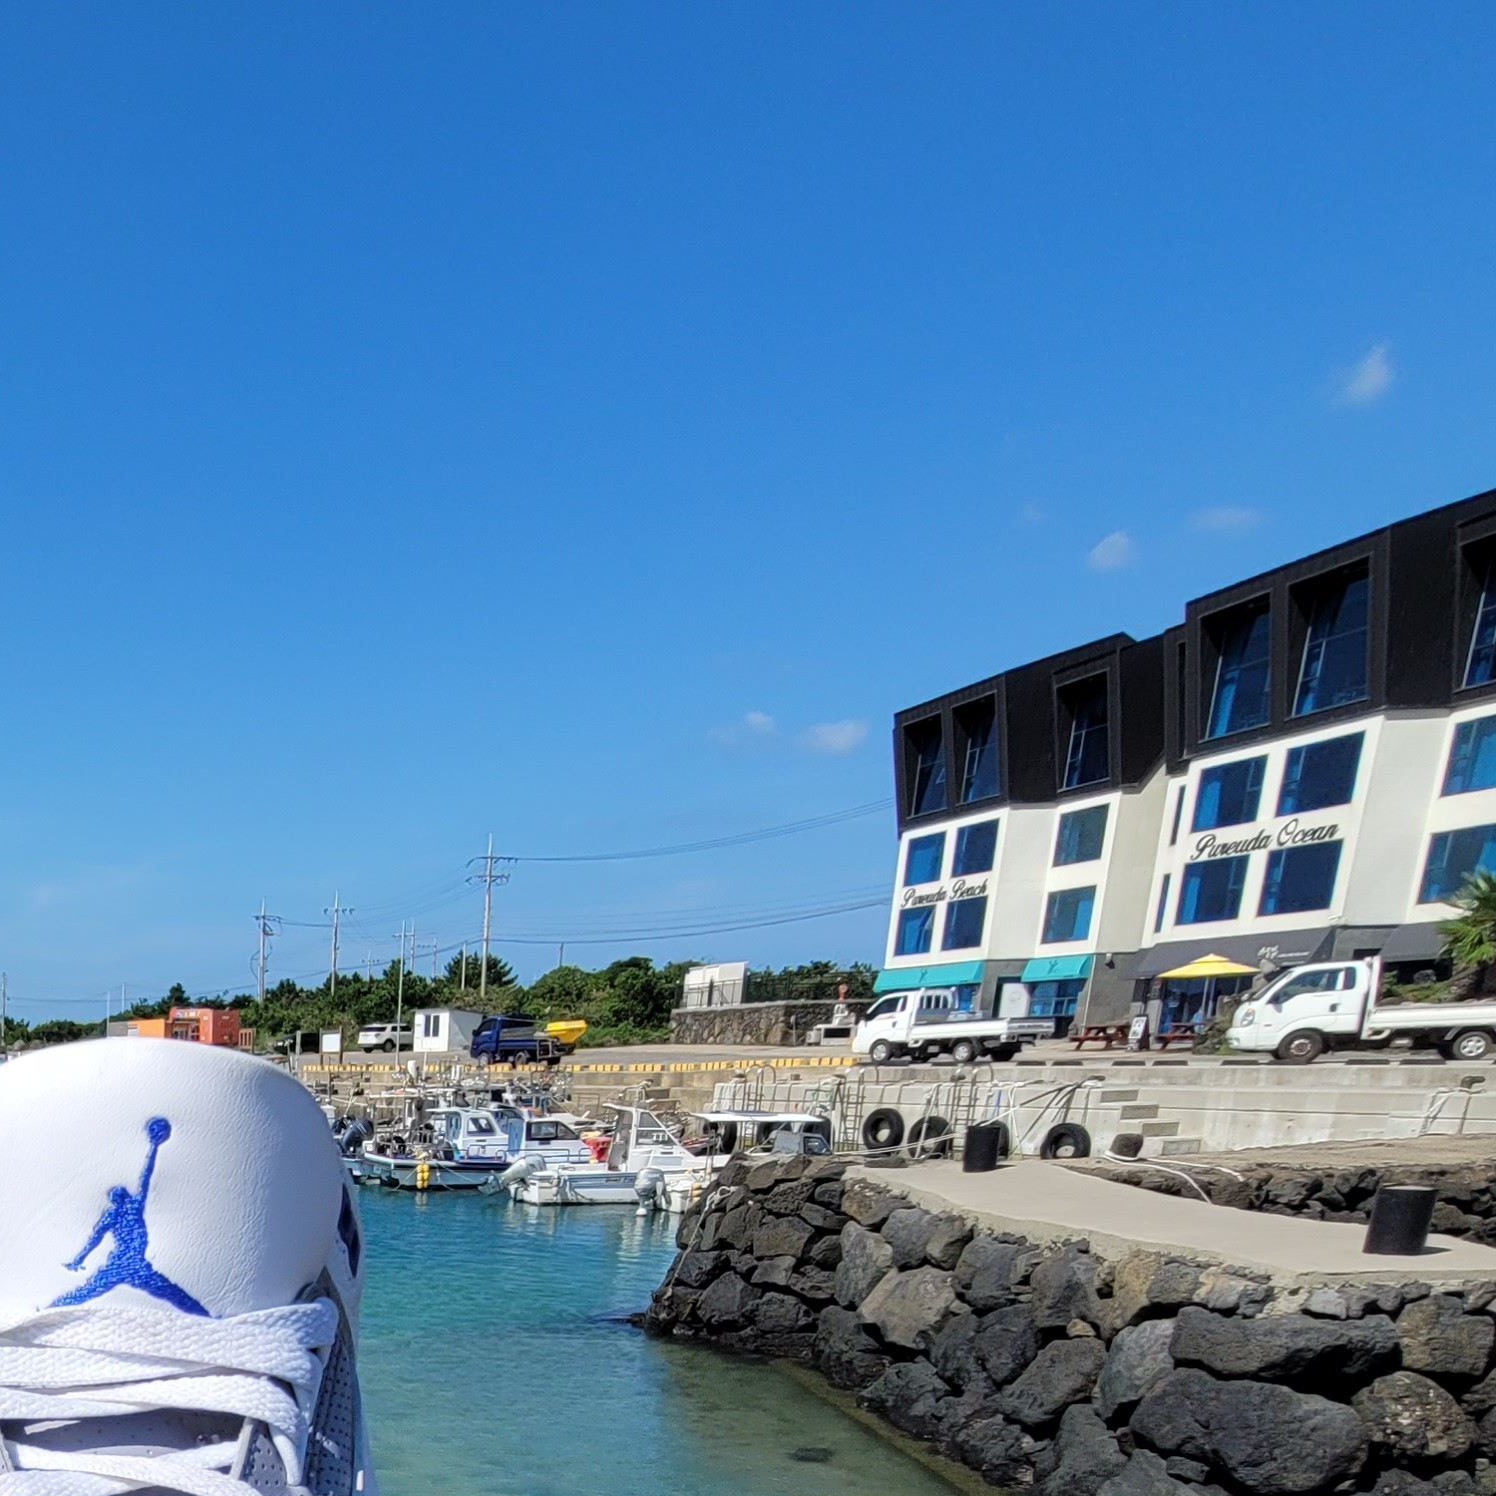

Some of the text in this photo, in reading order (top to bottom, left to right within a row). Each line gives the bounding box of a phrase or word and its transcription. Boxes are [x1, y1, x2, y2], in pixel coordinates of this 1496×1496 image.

[1190, 818, 1339, 861] Pureuda Ocean
[949, 879, 989, 900] Beach
